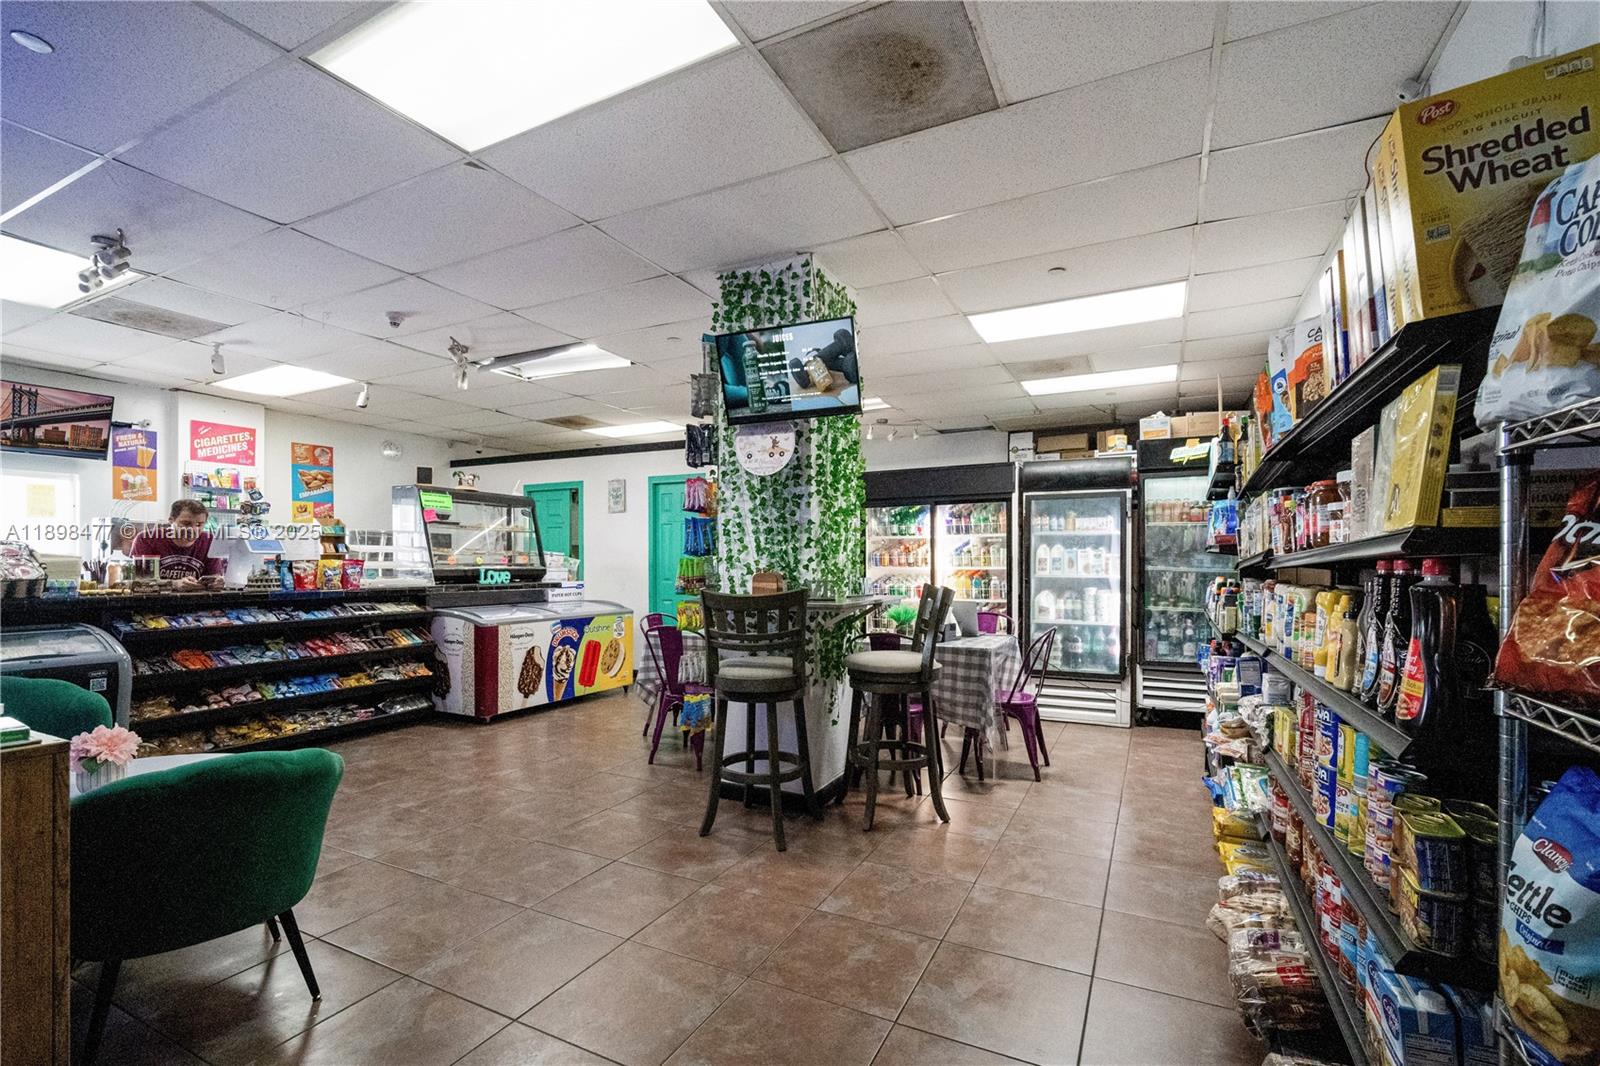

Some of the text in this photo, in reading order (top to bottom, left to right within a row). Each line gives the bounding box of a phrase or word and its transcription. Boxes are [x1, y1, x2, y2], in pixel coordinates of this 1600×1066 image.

[1421, 101, 1452, 124] Post
[1474, 103, 1516, 121] WHOLE
[1463, 108, 1543, 136] BIG BISCUIT
[1422, 105, 1591, 176] Shredded
[1446, 144, 1571, 193] Wheat
[772, 332, 794, 343] JUICES
[116, 433, 137, 441] FRESH
[118, 438, 147, 447] NATURAL
[194, 431, 254, 448] CIGARETTES,
[197, 442, 249, 457] MEDICINES
[160, 568, 197, 579] CAFETERIA
[479, 567, 511, 585] Love
[1533, 838, 1573, 872] Clancy's
[1509, 902, 1532, 925] CHIPS
